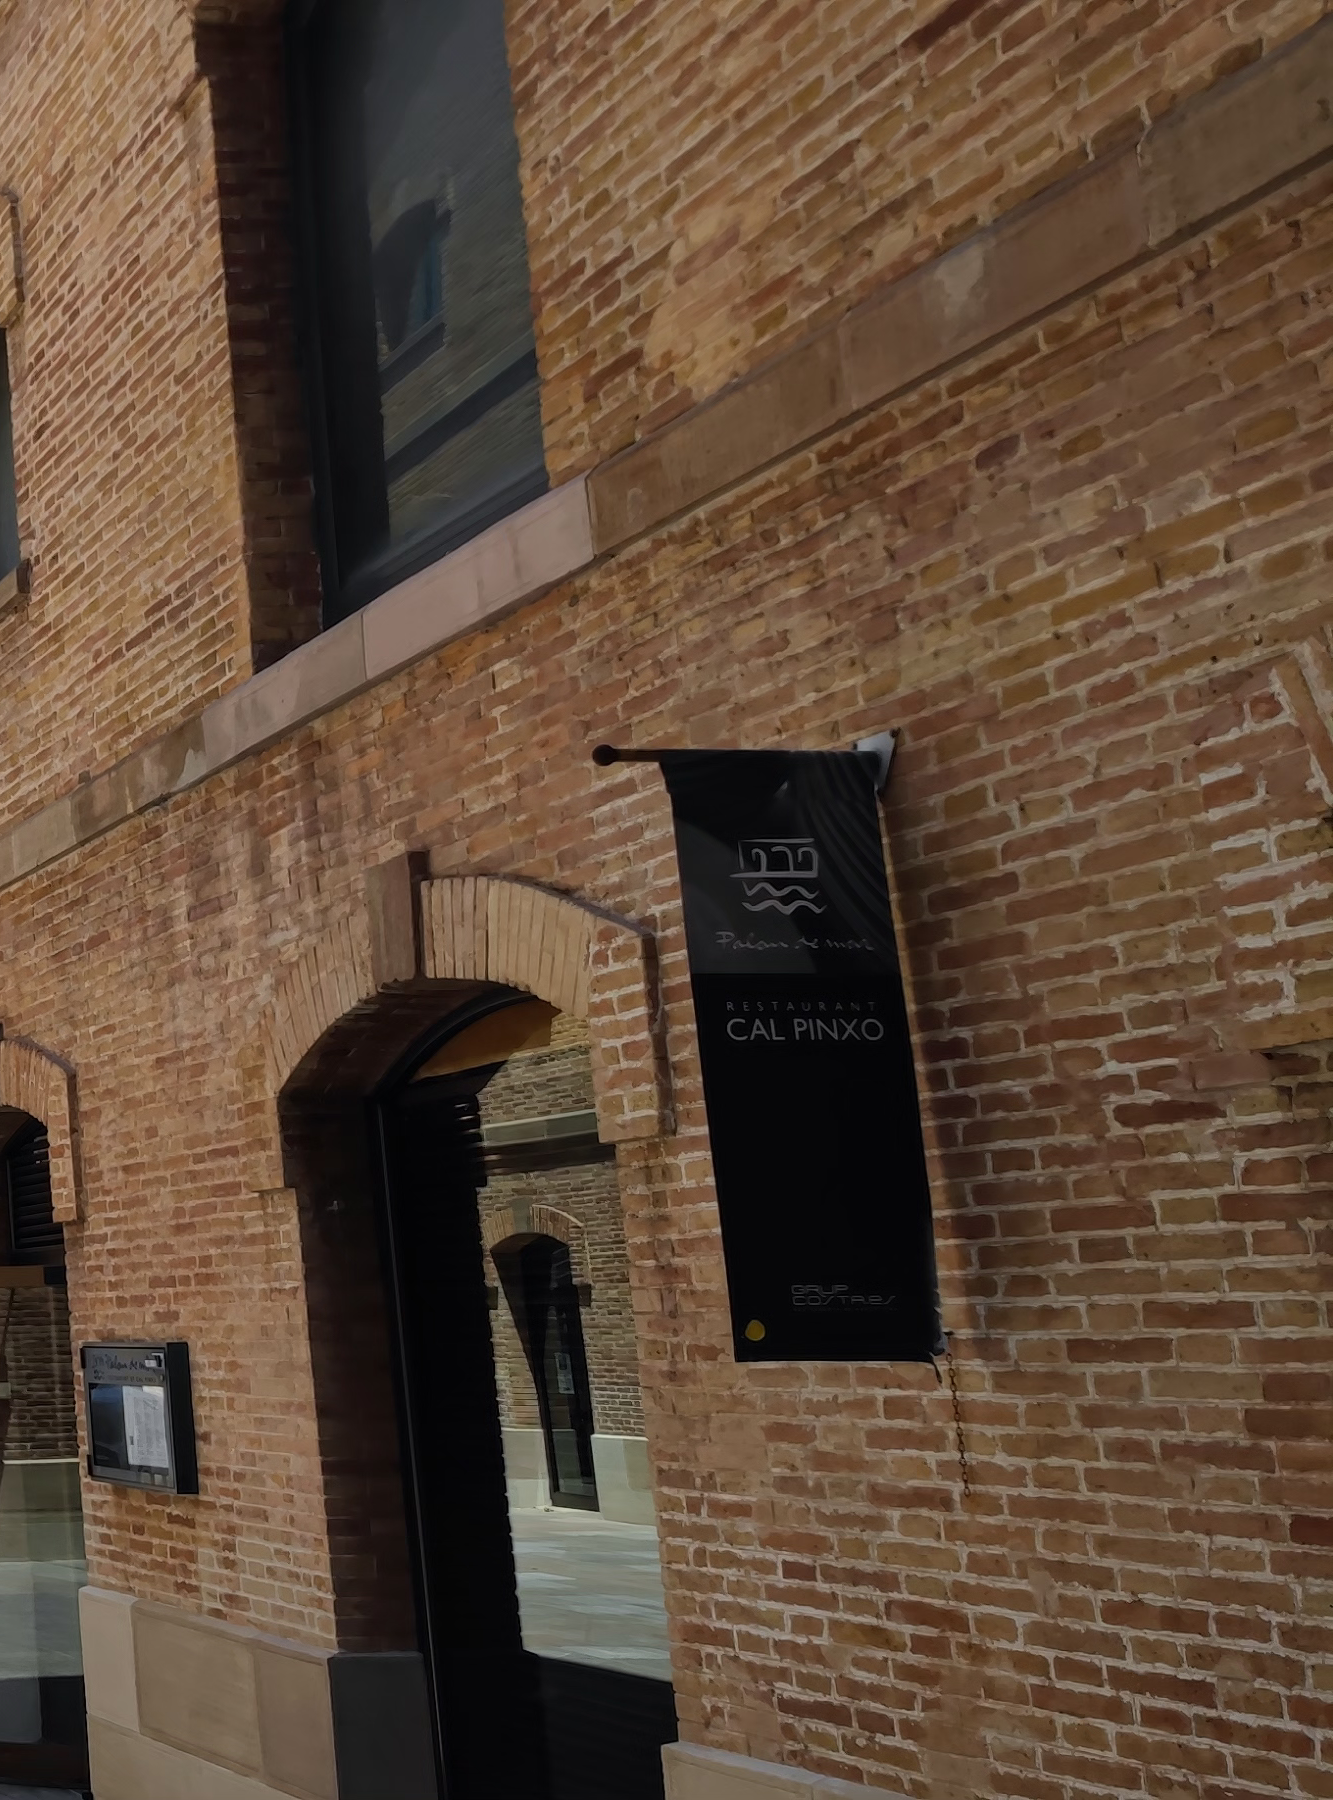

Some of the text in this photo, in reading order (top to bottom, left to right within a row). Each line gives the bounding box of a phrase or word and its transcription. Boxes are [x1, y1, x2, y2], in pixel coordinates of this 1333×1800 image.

[726, 1001, 876, 1012] RESTAURANT
[726, 1018, 885, 1041] CAL PINXO
